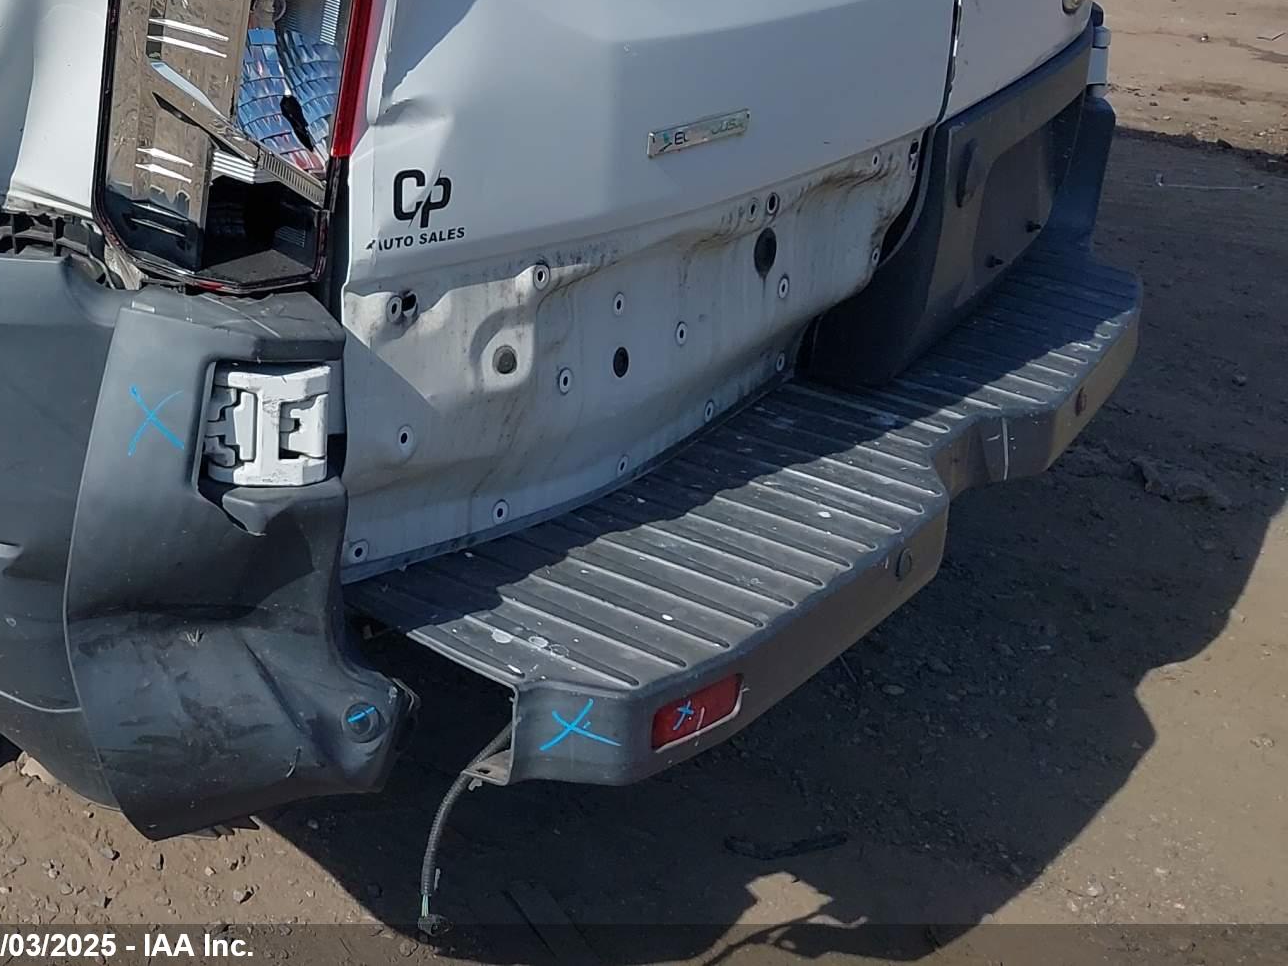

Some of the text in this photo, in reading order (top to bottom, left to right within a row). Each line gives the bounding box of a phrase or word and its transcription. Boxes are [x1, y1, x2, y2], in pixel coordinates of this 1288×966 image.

[392, 169, 453, 229] CP
[365, 227, 466, 252] AUTO SALES
